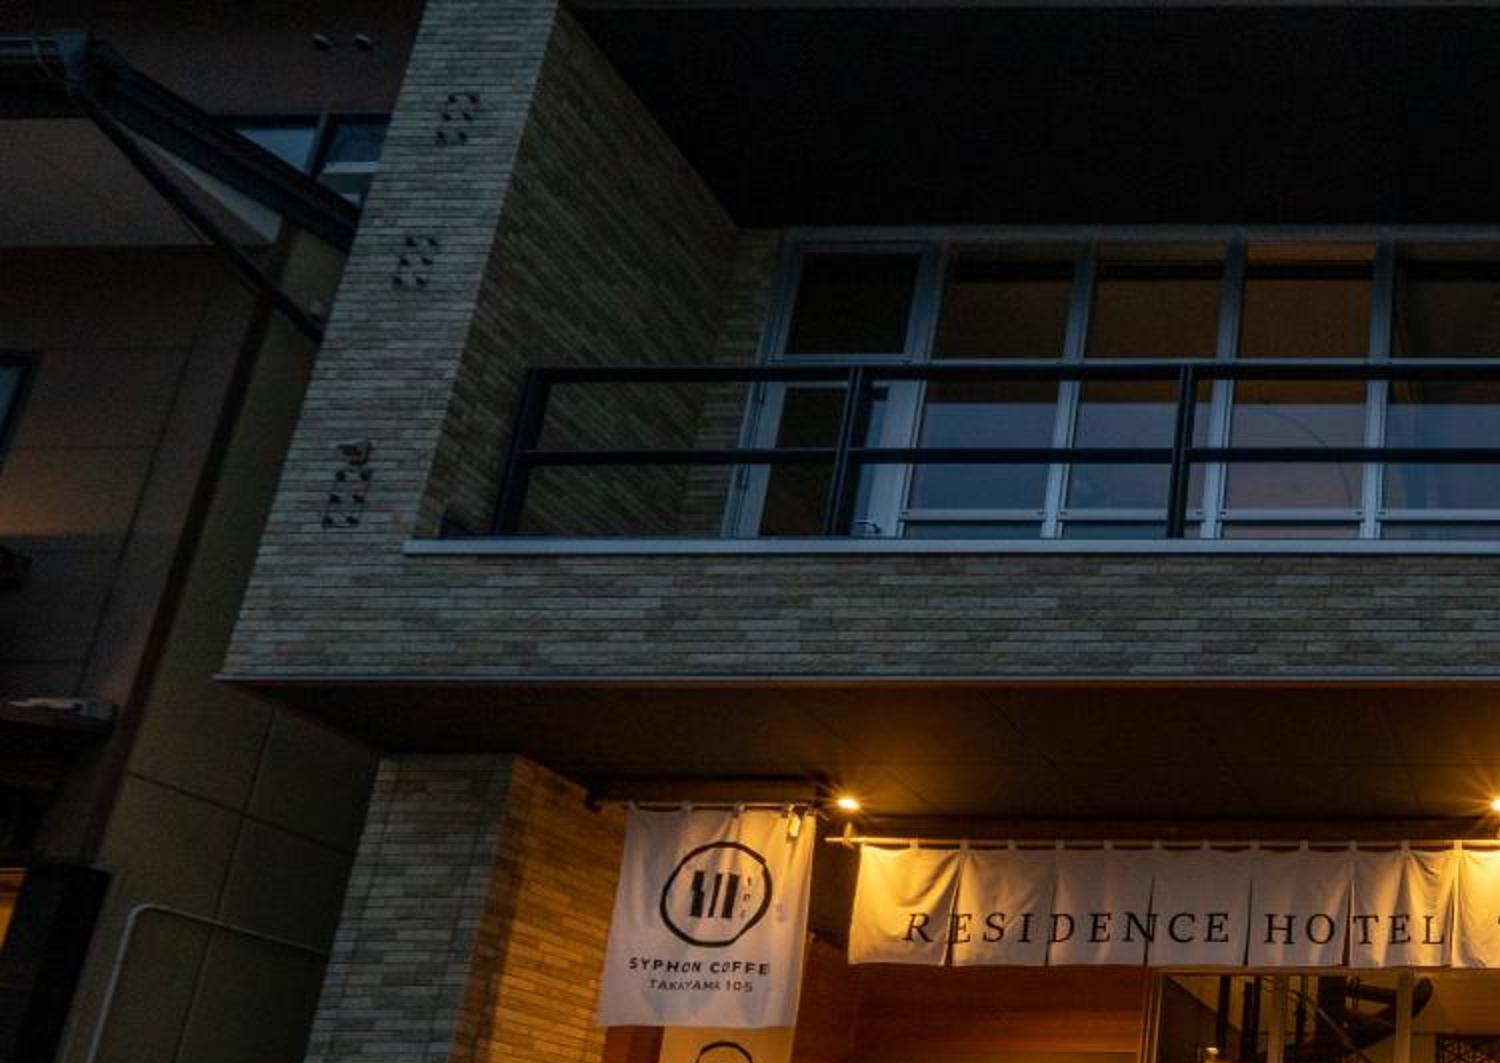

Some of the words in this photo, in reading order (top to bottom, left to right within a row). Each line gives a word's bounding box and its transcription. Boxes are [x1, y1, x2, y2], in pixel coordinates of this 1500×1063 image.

[903, 912, 1230, 944] RESIDENCE
[1264, 913, 1446, 945] HOTEL
[628, 957, 702, 973] SYPHON
[710, 961, 770, 976] COFFE
